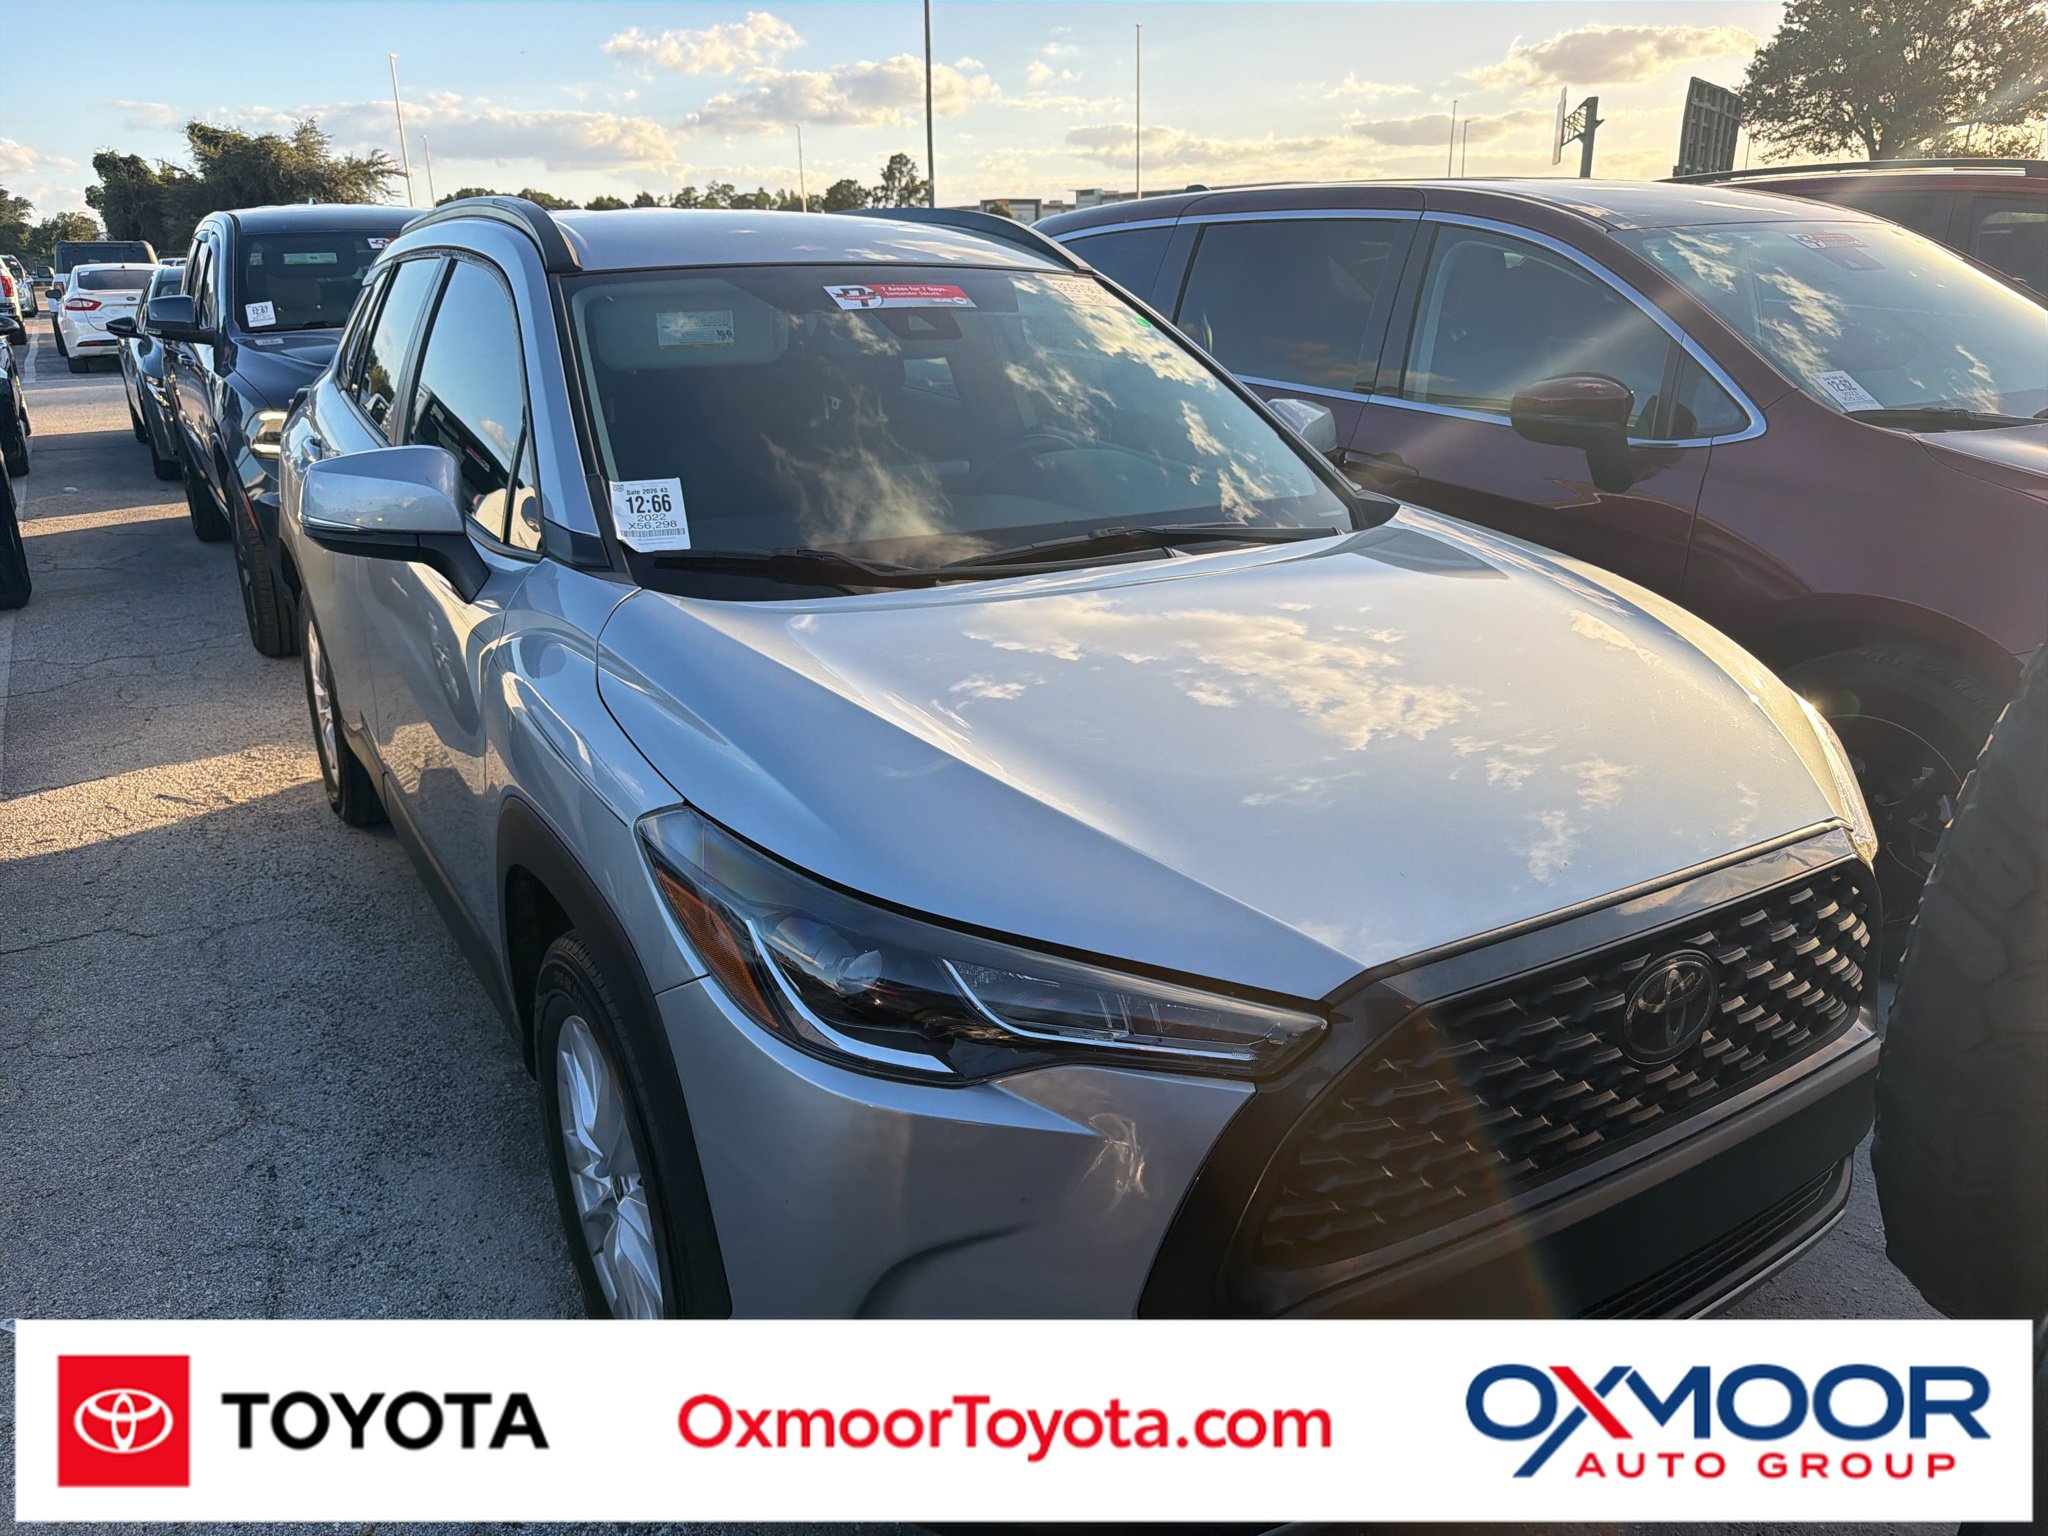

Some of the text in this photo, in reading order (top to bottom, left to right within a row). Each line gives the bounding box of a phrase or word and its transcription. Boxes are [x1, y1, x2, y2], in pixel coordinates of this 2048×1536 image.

[625, 494, 672, 514] 12:66
[637, 513, 667, 522] 2022
[628, 520, 678, 530] X56,298
